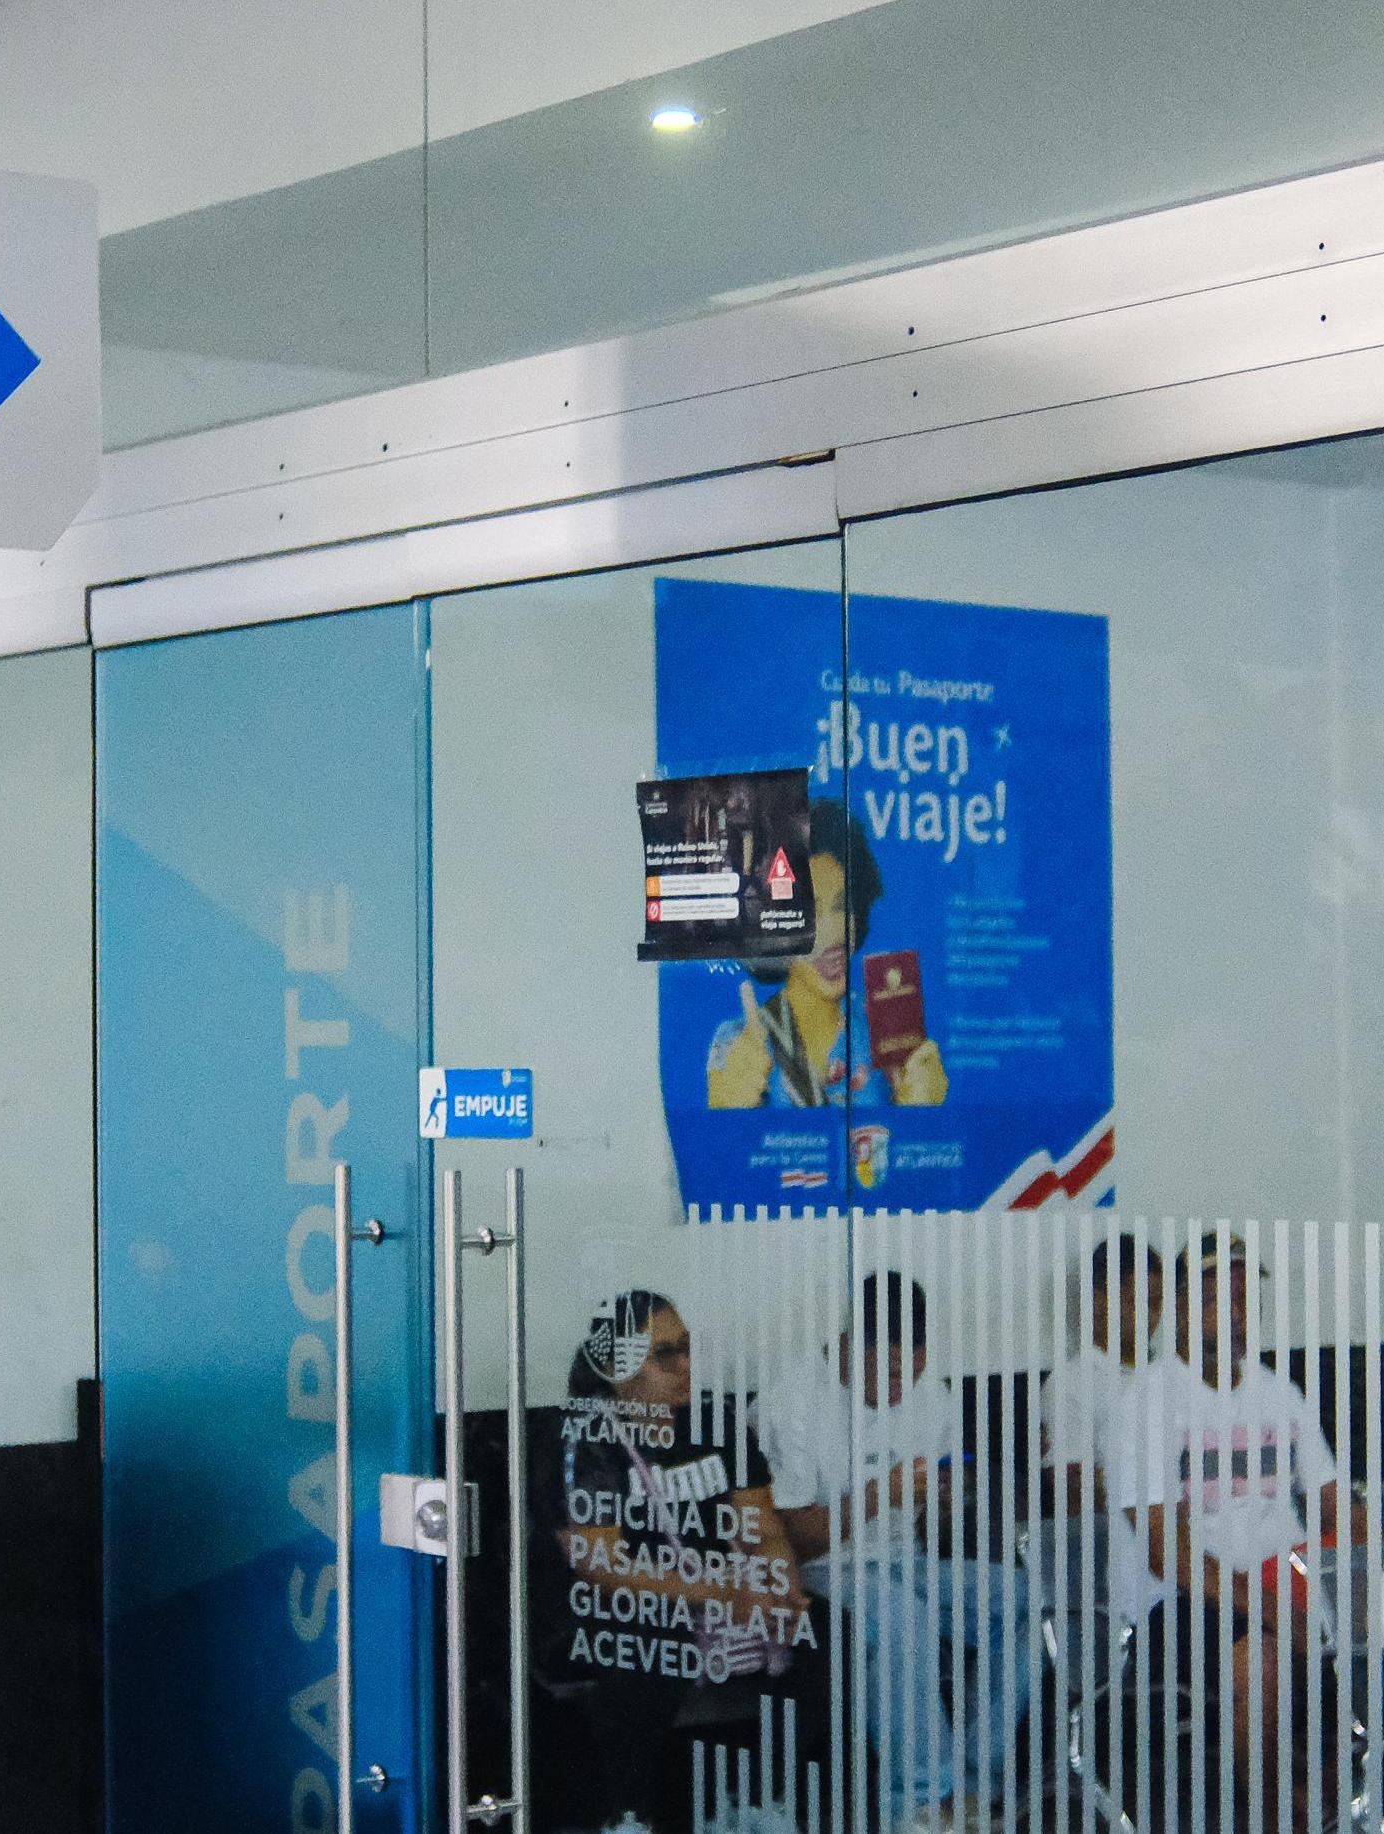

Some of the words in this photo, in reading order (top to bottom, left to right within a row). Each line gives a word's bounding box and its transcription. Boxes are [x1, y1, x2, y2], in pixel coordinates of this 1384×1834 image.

[821, 669, 871, 693] Cuda
[865, 770, 1007, 863] viaje!
[454, 1095, 528, 1117] EMPUJE
[284, 882, 351, 1834] PASAPORTE
[568, 1490, 706, 1537] OFICINA
[716, 1505, 762, 1546] DE
[570, 1537, 791, 1597] PASAPORTES
[570, 1580, 694, 1632] GLORIA
[704, 1600, 818, 1650] PLATA
[570, 1627, 729, 1685] ACEVEDO
